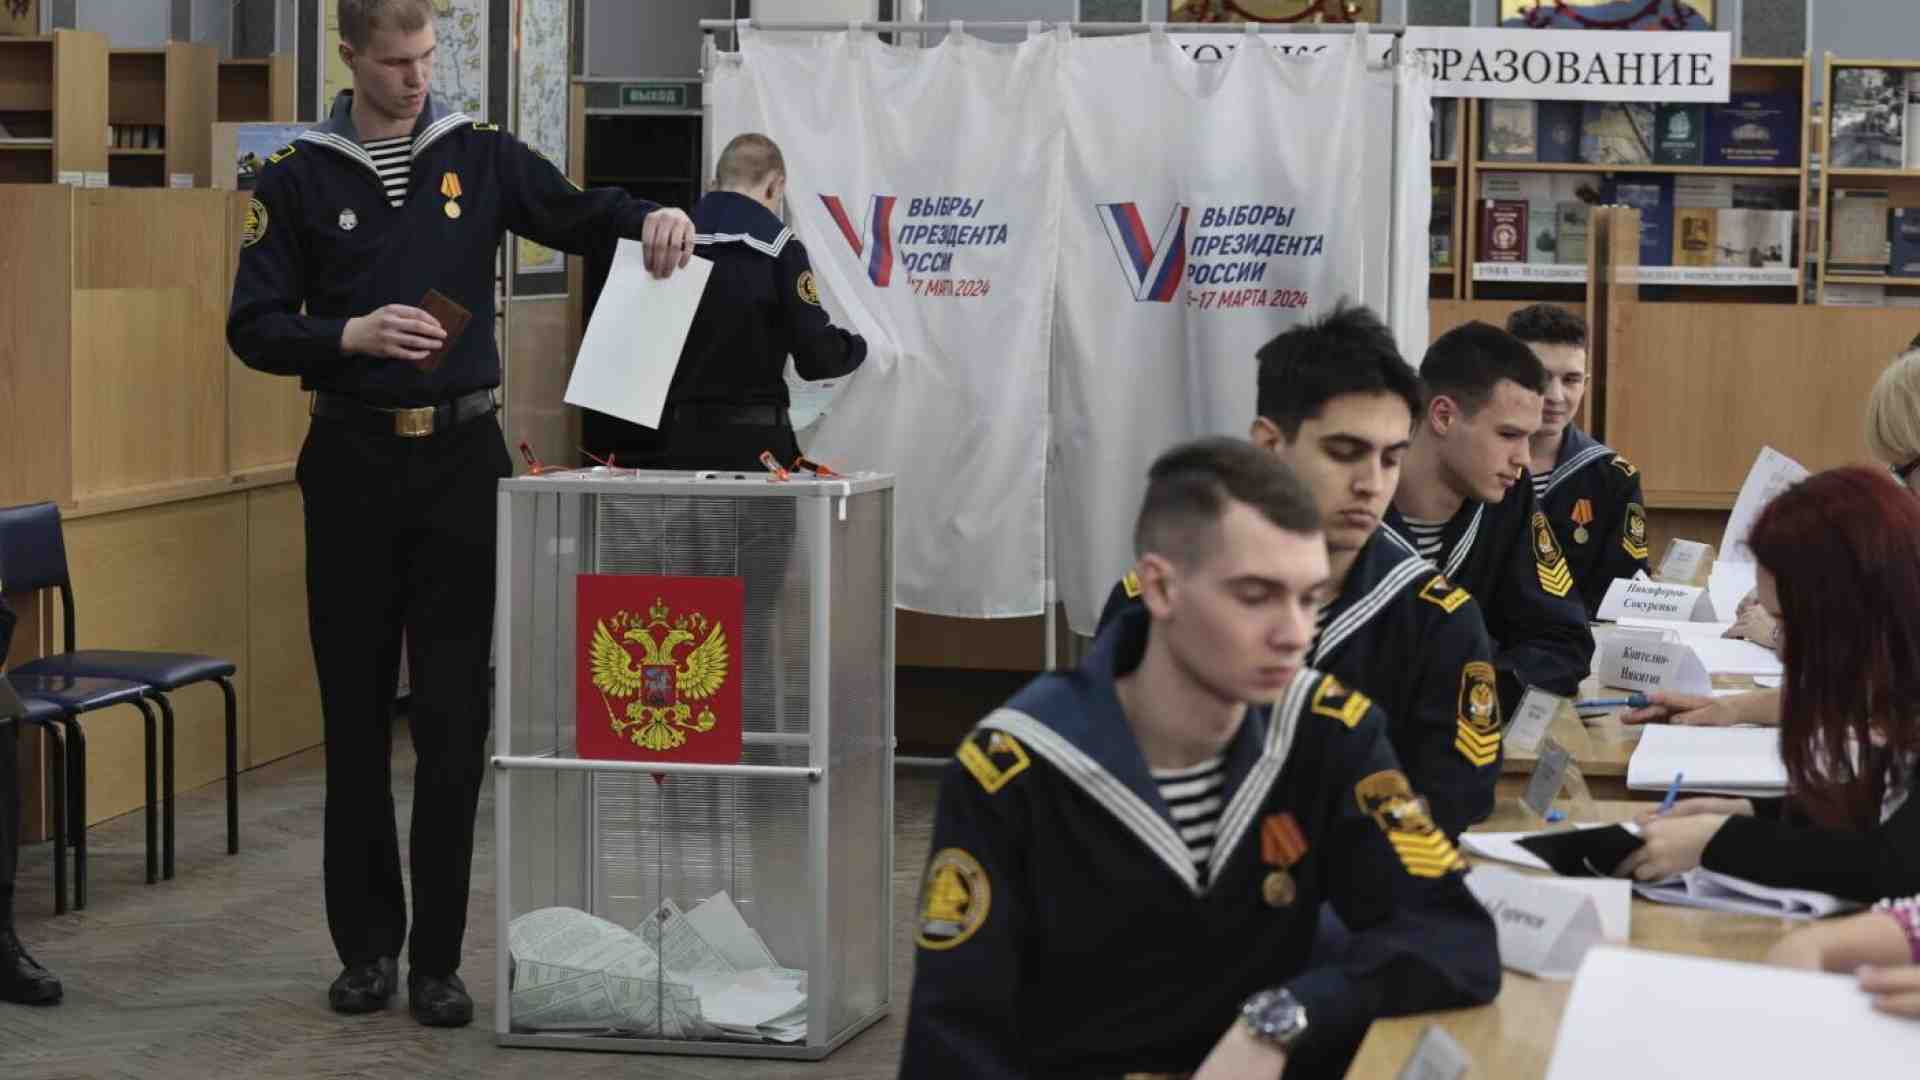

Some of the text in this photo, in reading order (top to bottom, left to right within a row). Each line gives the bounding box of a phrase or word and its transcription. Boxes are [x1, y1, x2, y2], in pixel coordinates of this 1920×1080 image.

[1383, 47, 1714, 87] БРАЗОВАНИЕ
[630, 89, 675, 103] ВЫХОД
[908, 197, 984, 218] ВЫБРЫ
[1200, 206, 1296, 227] ВЫБОРЫ
[898, 224, 1008, 247] ПРЕЗДЕНТА
[1189, 233, 1324, 256] ПРЕЗИДЕНТА
[955, 279, 991, 296] 2024
[1218, 289, 1267, 308] МАРТА
[1269, 288, 1308, 308] 2024
